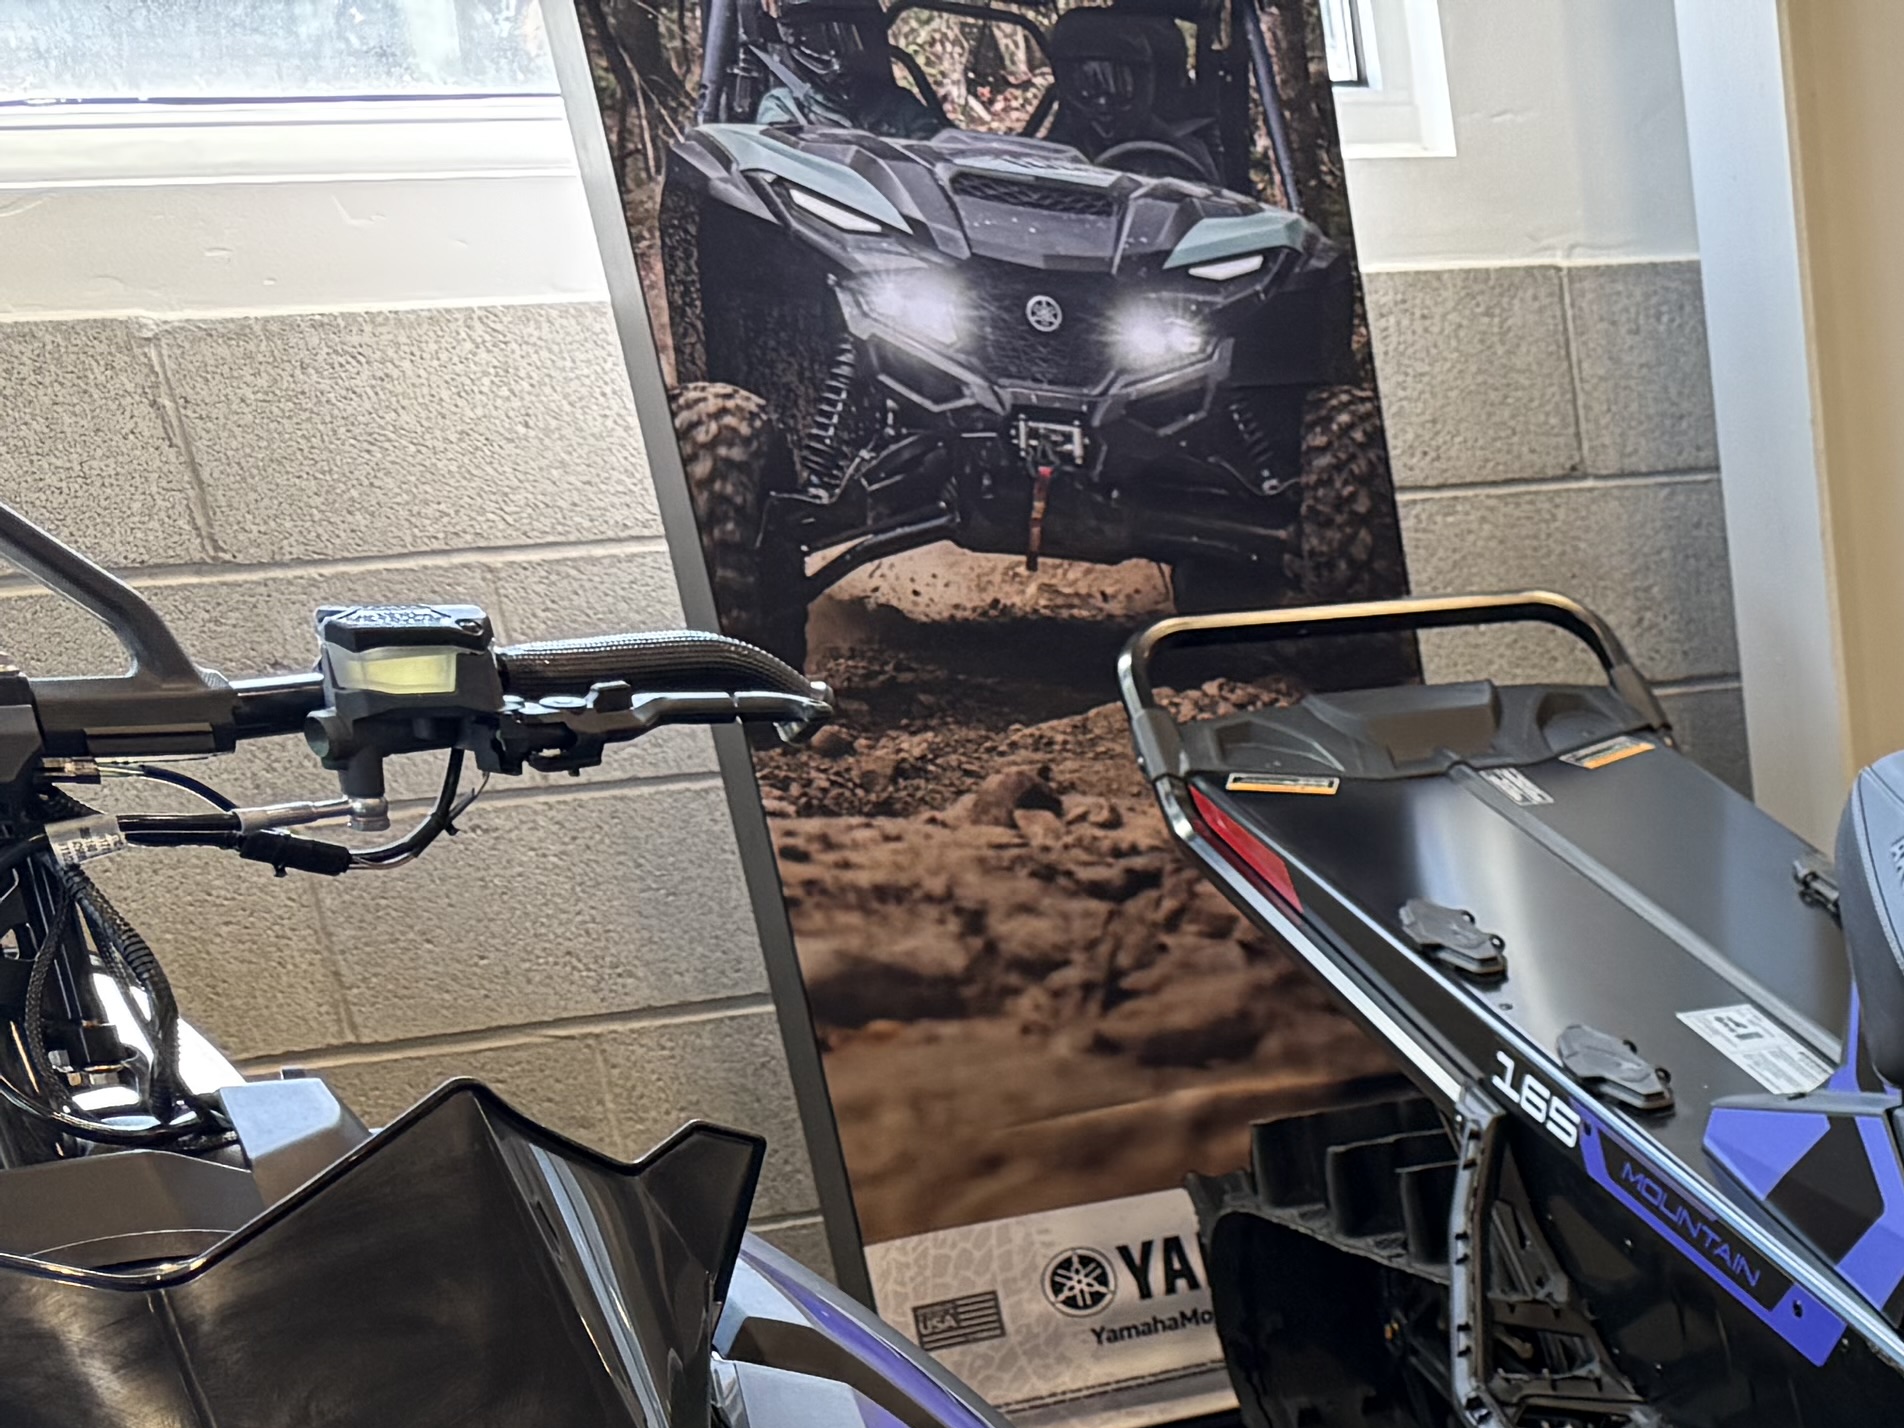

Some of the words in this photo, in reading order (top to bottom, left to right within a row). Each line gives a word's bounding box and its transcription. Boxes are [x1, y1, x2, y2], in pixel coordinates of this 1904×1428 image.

[1492, 1050, 1581, 1148] 165
[1115, 1232, 1210, 1300] YA
[1622, 1162, 1760, 1287] MOUNTAIN
[920, 1311, 958, 1336] USA
